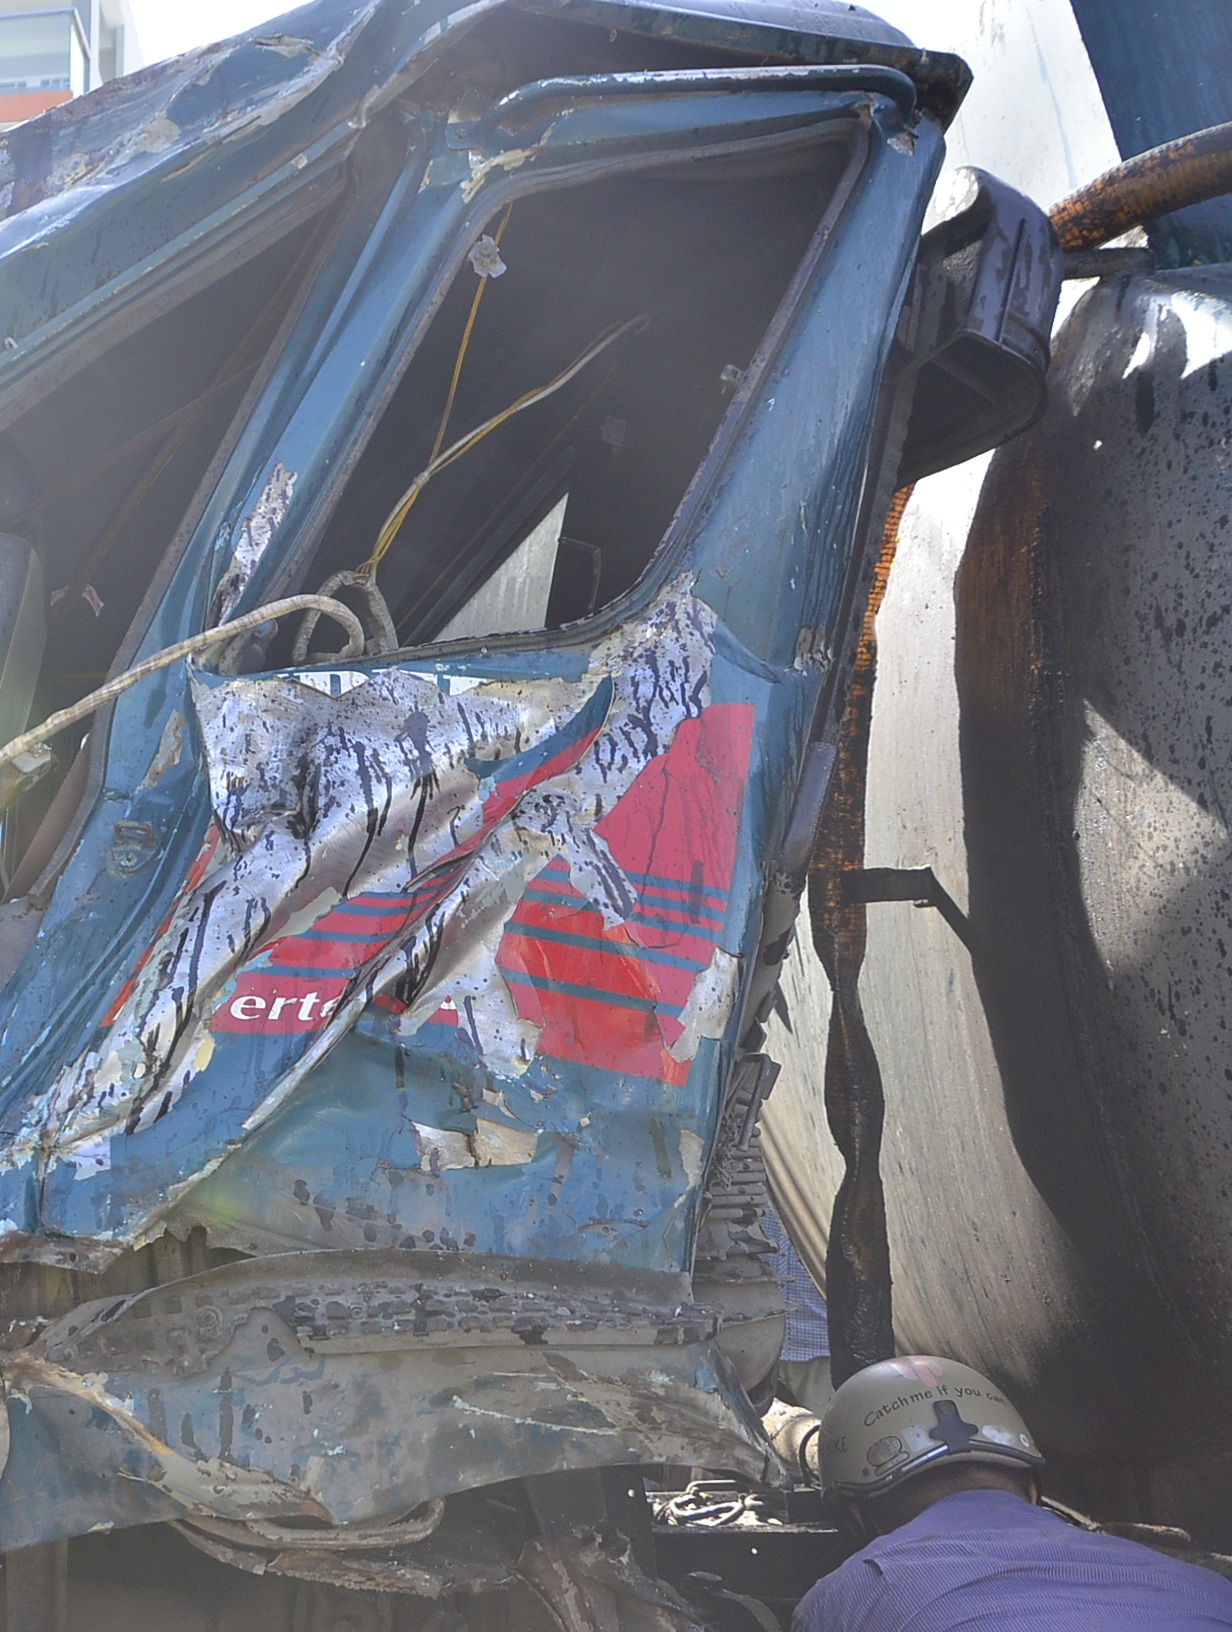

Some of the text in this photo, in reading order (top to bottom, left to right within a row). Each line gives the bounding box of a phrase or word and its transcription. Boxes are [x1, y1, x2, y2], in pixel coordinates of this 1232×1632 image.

[863, 1397, 909, 1427] Catch
[910, 1390, 933, 1403] me
[954, 1387, 981, 1398] you
